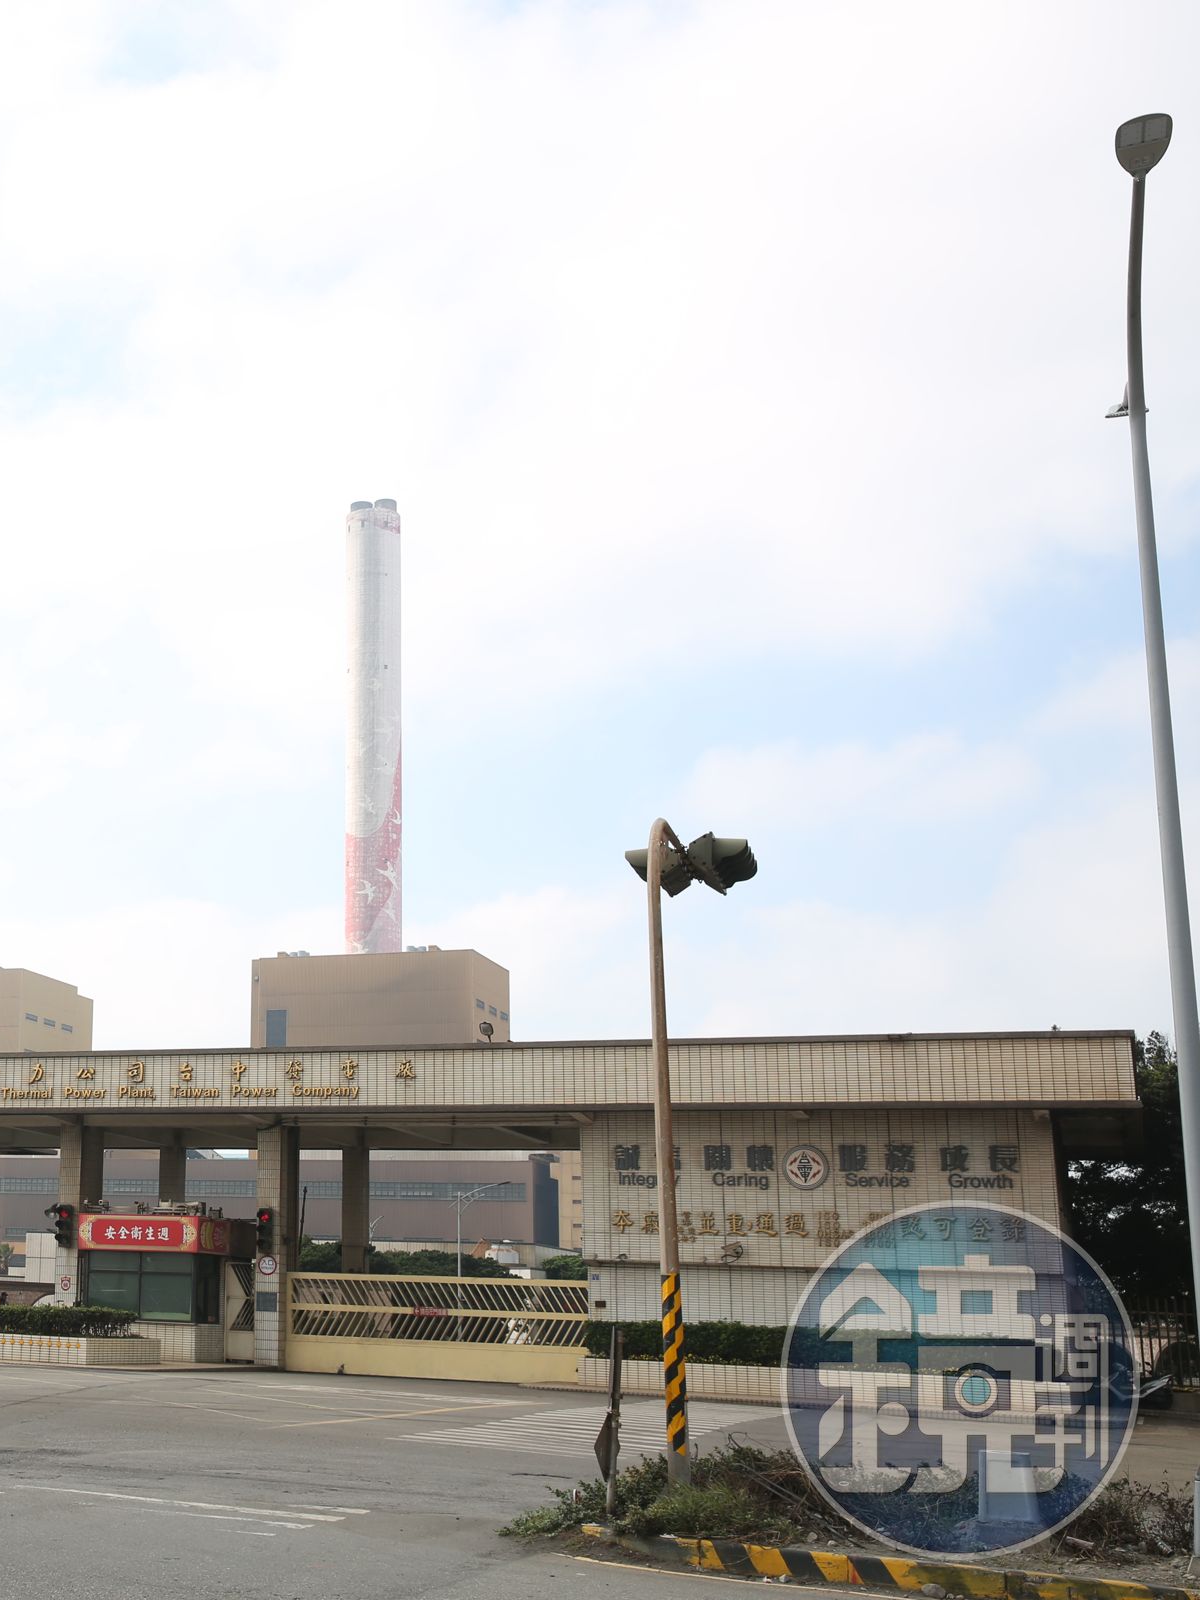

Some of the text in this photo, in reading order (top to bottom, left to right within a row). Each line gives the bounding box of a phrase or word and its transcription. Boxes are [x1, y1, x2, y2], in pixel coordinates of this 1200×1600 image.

[1, 1086, 53, 1100] Thermal
[64, 1086, 106, 1099] Power
[118, 1085, 156, 1101] Plant,
[170, 1085, 220, 1098] Taiwan
[232, 1084, 279, 1098] Power
[291, 1084, 360, 1099] Company
[712, 1172, 769, 1190] Caring
[845, 1172, 911, 1188] Service
[947, 1173, 1014, 1189] Growth
